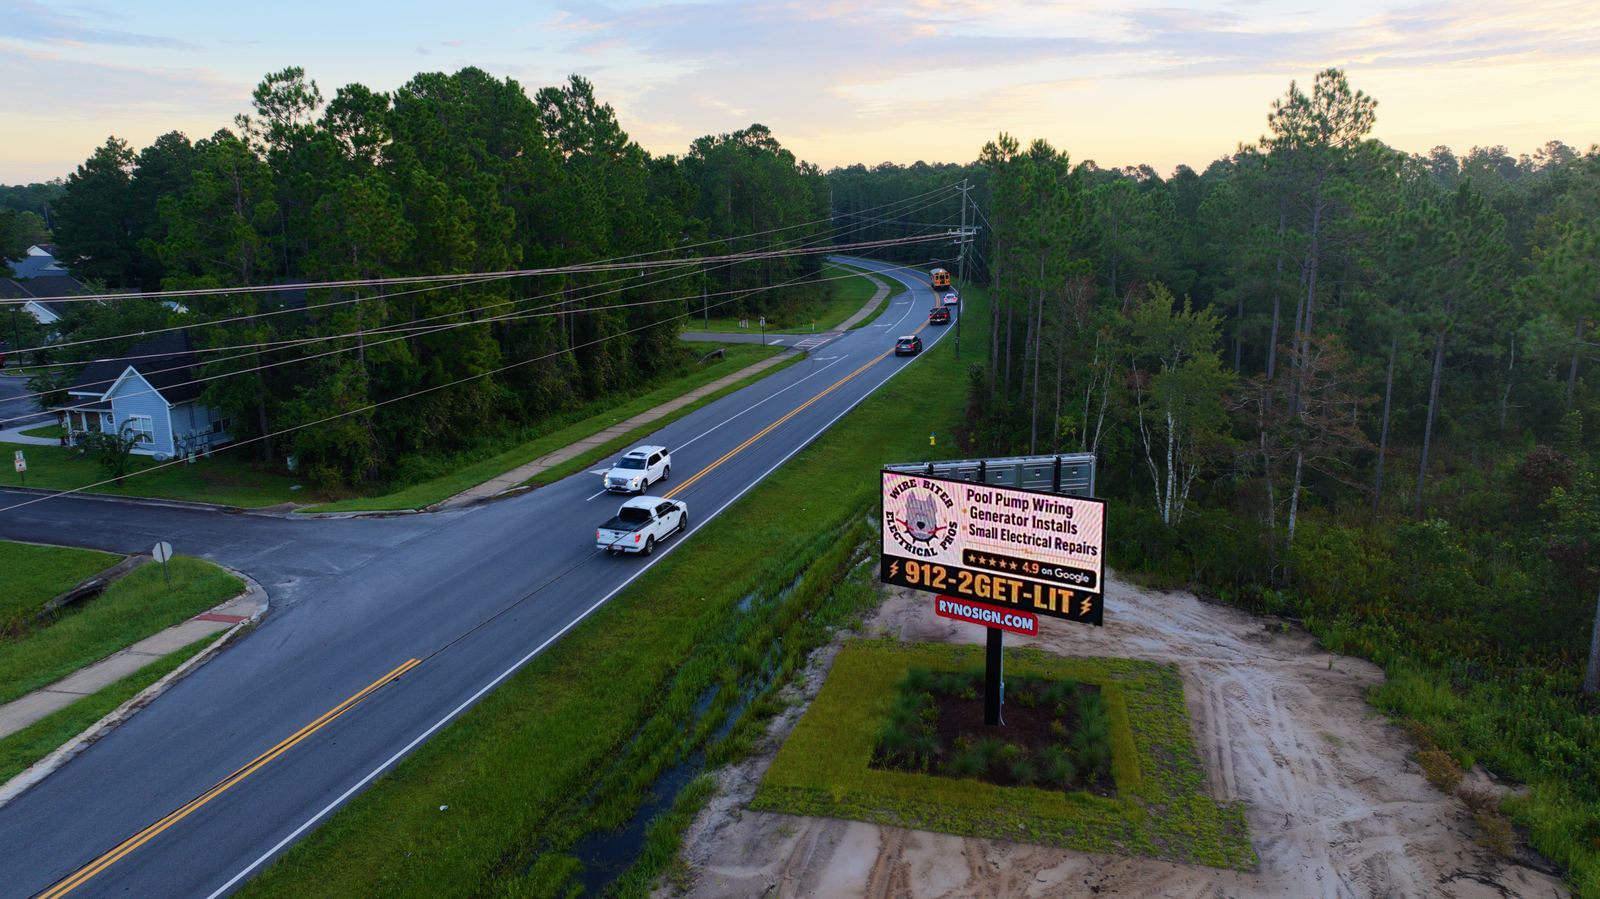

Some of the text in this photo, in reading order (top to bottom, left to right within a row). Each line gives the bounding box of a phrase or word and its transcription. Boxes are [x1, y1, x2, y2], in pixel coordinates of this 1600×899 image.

[890, 479, 953, 508] WIRE BITER
[967, 489, 1073, 518] Pool Pump Wiring
[886, 511, 957, 556] ELECTRICAL PROS
[970, 506, 1077, 534] Generator Installs
[969, 523, 1097, 556] Small Electrical Repairs
[905, 561, 1074, 613] 912-2GET-LIT
[1022, 562, 1039, 573] 4.9
[1055, 568, 1089, 583] Google
[939, 600, 1033, 630] RYNOSIGN.COM
